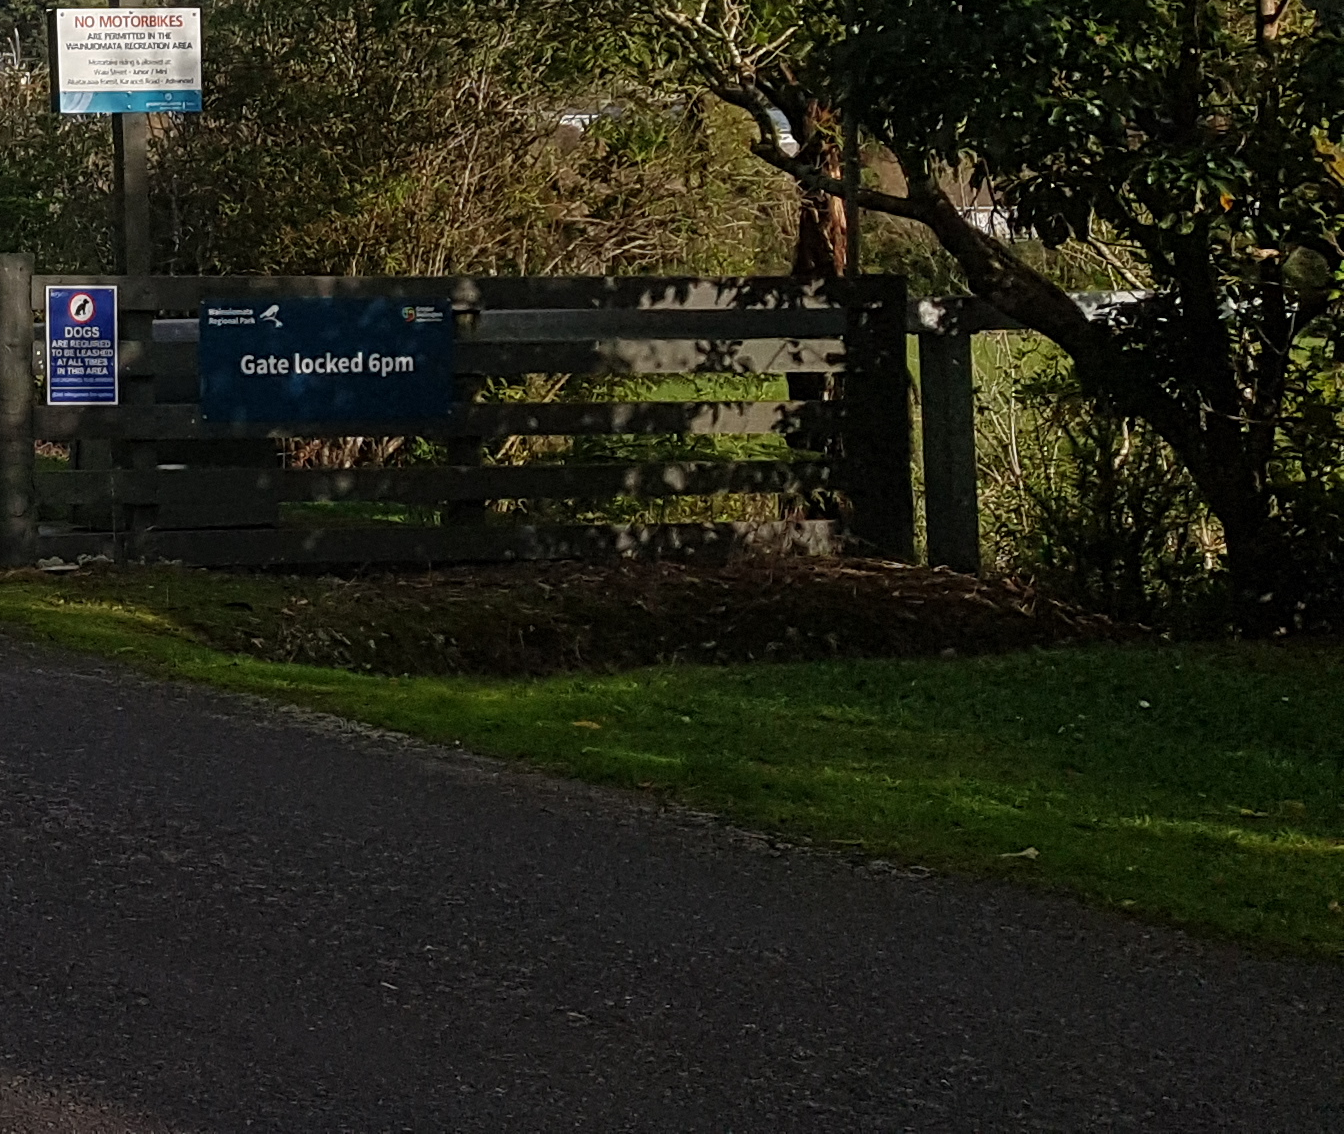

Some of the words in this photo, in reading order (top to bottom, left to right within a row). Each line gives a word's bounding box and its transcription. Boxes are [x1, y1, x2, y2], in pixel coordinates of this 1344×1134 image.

[75, 15, 95, 28] NO
[99, 15, 184, 28] MOTORBIKES
[87, 32, 102, 40] ARE
[104, 32, 146, 40] PERMITTED
[148, 31, 156, 40] IN
[157, 31, 172, 40] THE
[66, 42, 123, 51] WAINUIOMATA
[124, 42, 170, 50] RECREATION
[172, 41, 193, 50] AREA
[208, 317, 239, 326] Regional
[64, 326, 100, 338] DOGS
[52, 340, 68, 348] ARE
[69, 340, 111, 348] REQUIRED
[52, 349, 63, 357] TO
[63, 349, 75, 357] BE
[76, 349, 114, 357] LEASHED
[56, 358, 67, 366] AT
[67, 358, 83, 366] ALL
[84, 358, 109, 366] TIMES
[240, 354, 289, 375] Gate
[294, 351, 363, 374] locked
[368, 352, 414, 378] 6pm
[56, 367, 66, 375] IN
[67, 367, 85, 375] THIS
[85, 367, 109, 375] AREA
